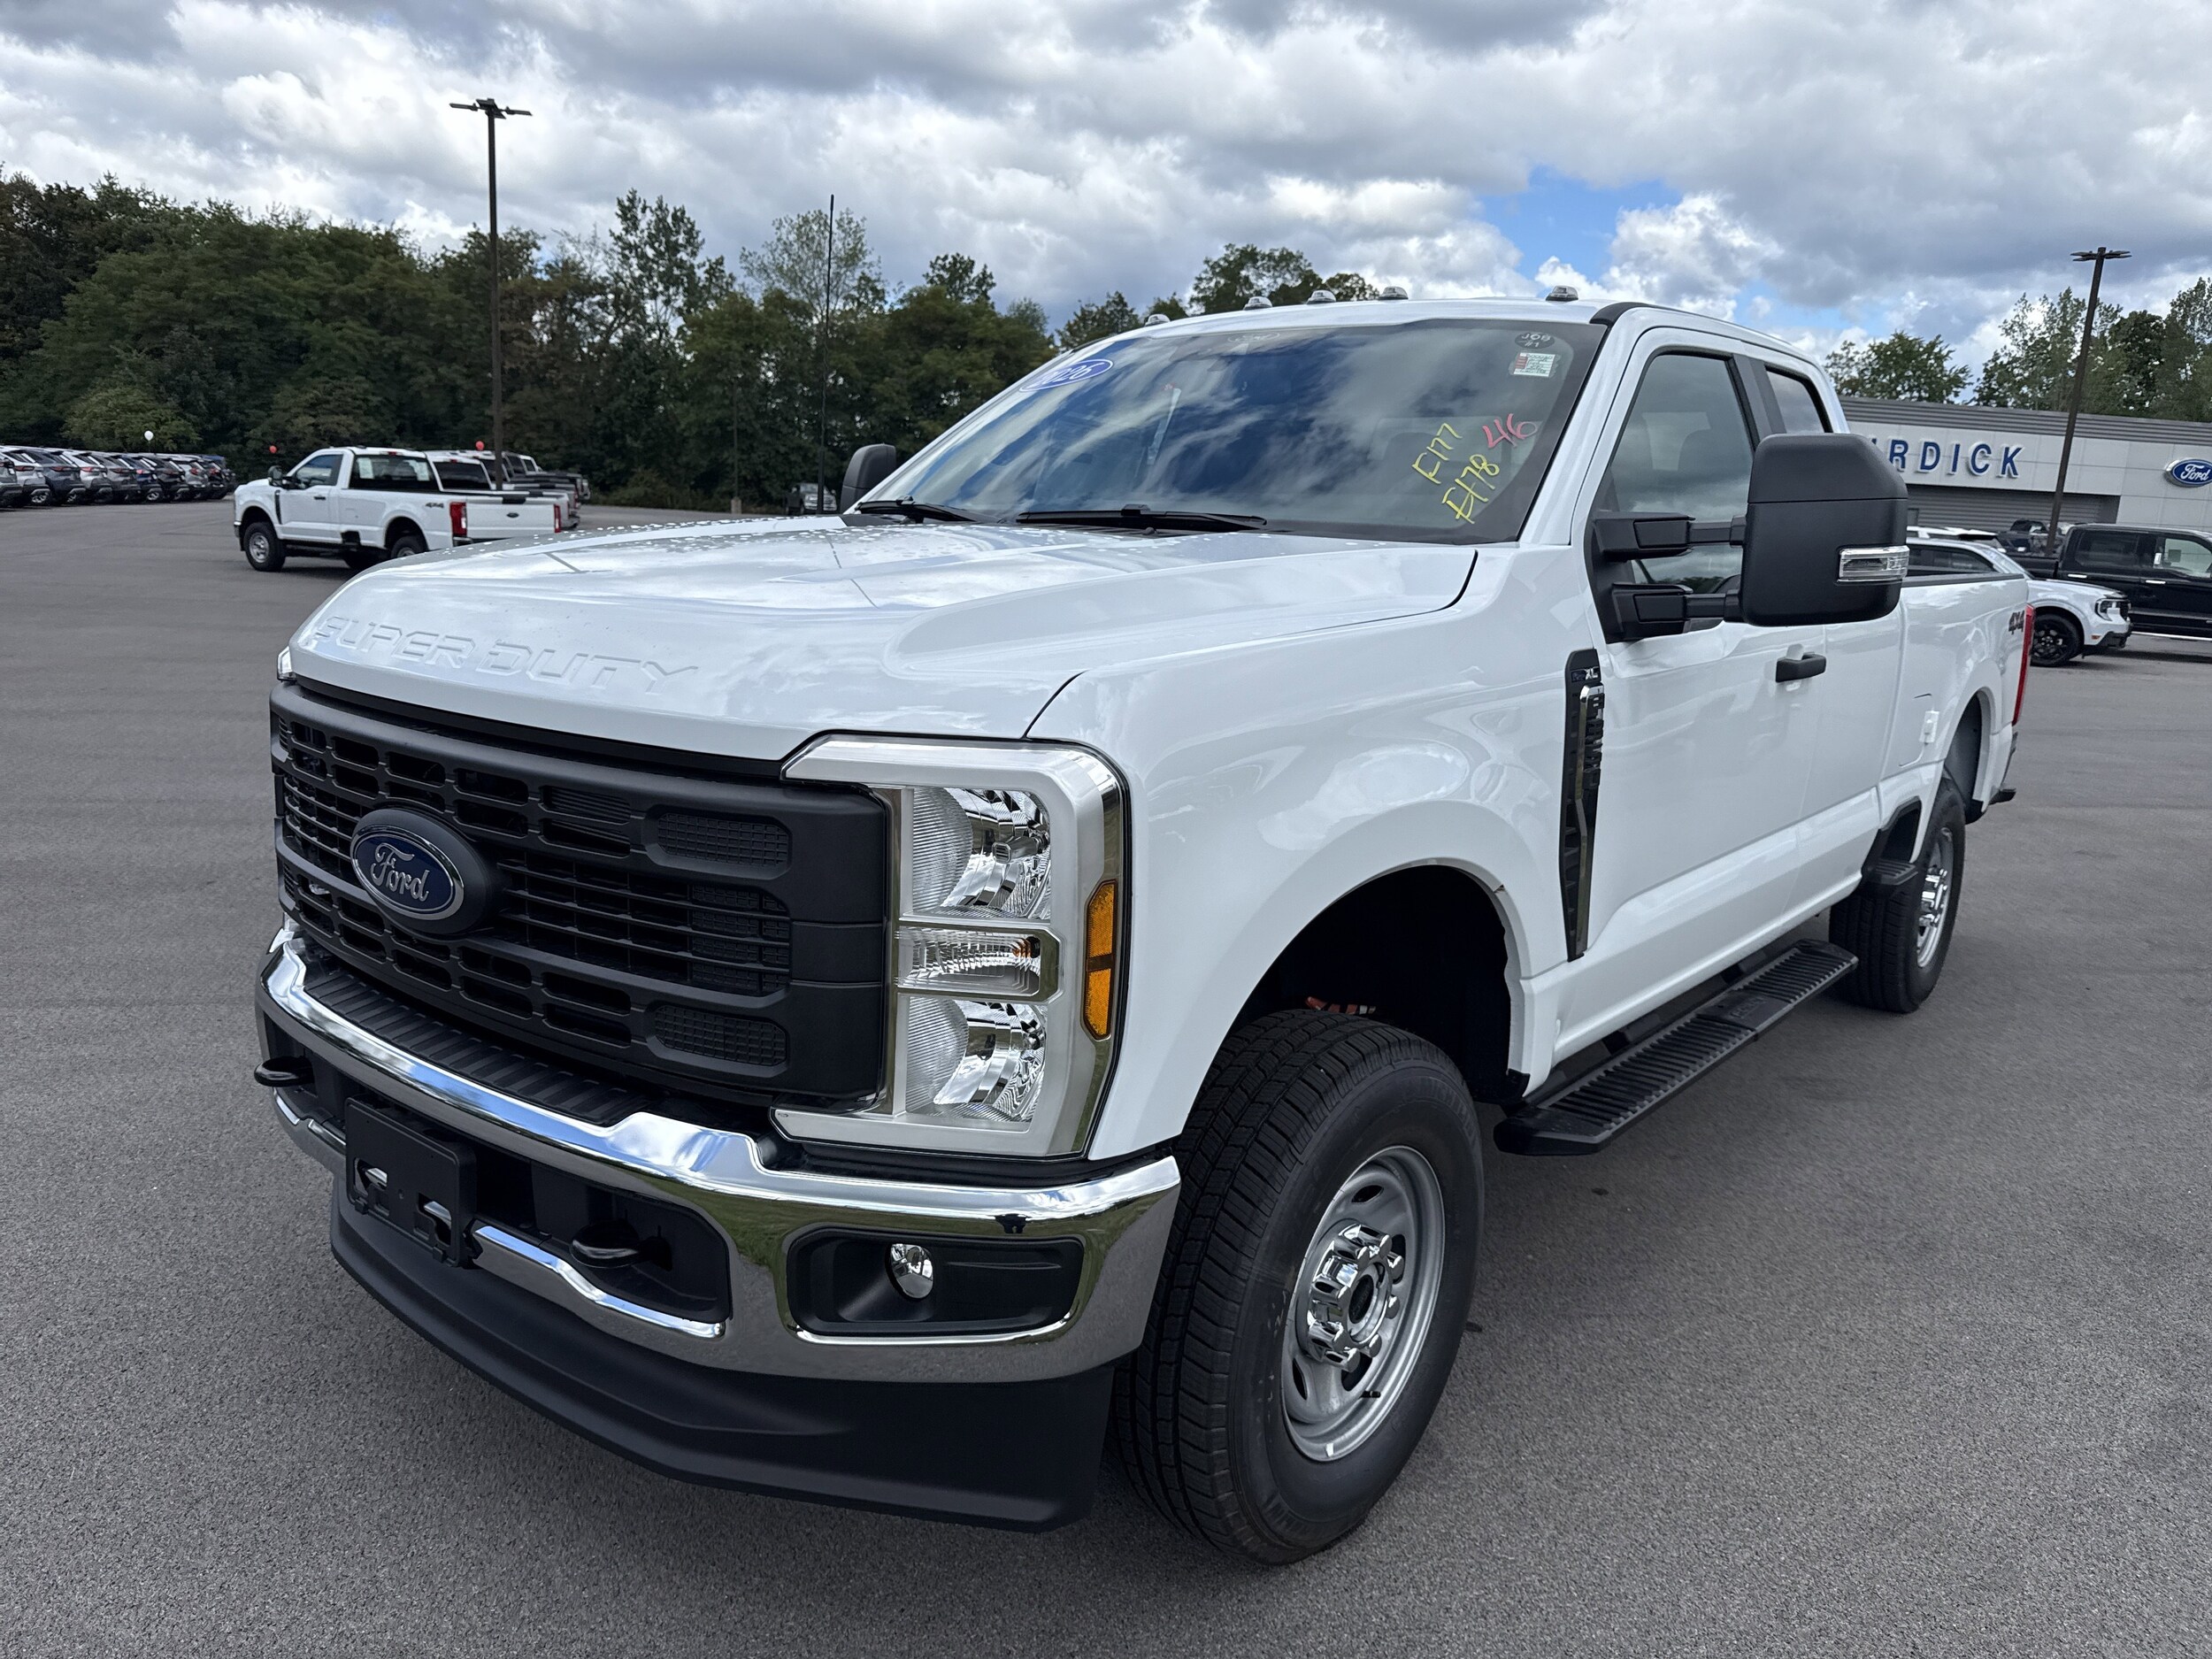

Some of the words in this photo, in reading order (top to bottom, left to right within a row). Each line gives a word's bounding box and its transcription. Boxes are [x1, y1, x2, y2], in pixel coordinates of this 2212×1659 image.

[1482, 412, 1539, 449] 46
[1870, 437, 2024, 477] RDICK
[2179, 463, 2212, 481] Ford
[313, 616, 476, 669] SUPER
[475, 639, 699, 694] DUTY
[370, 842, 431, 902] Ford
